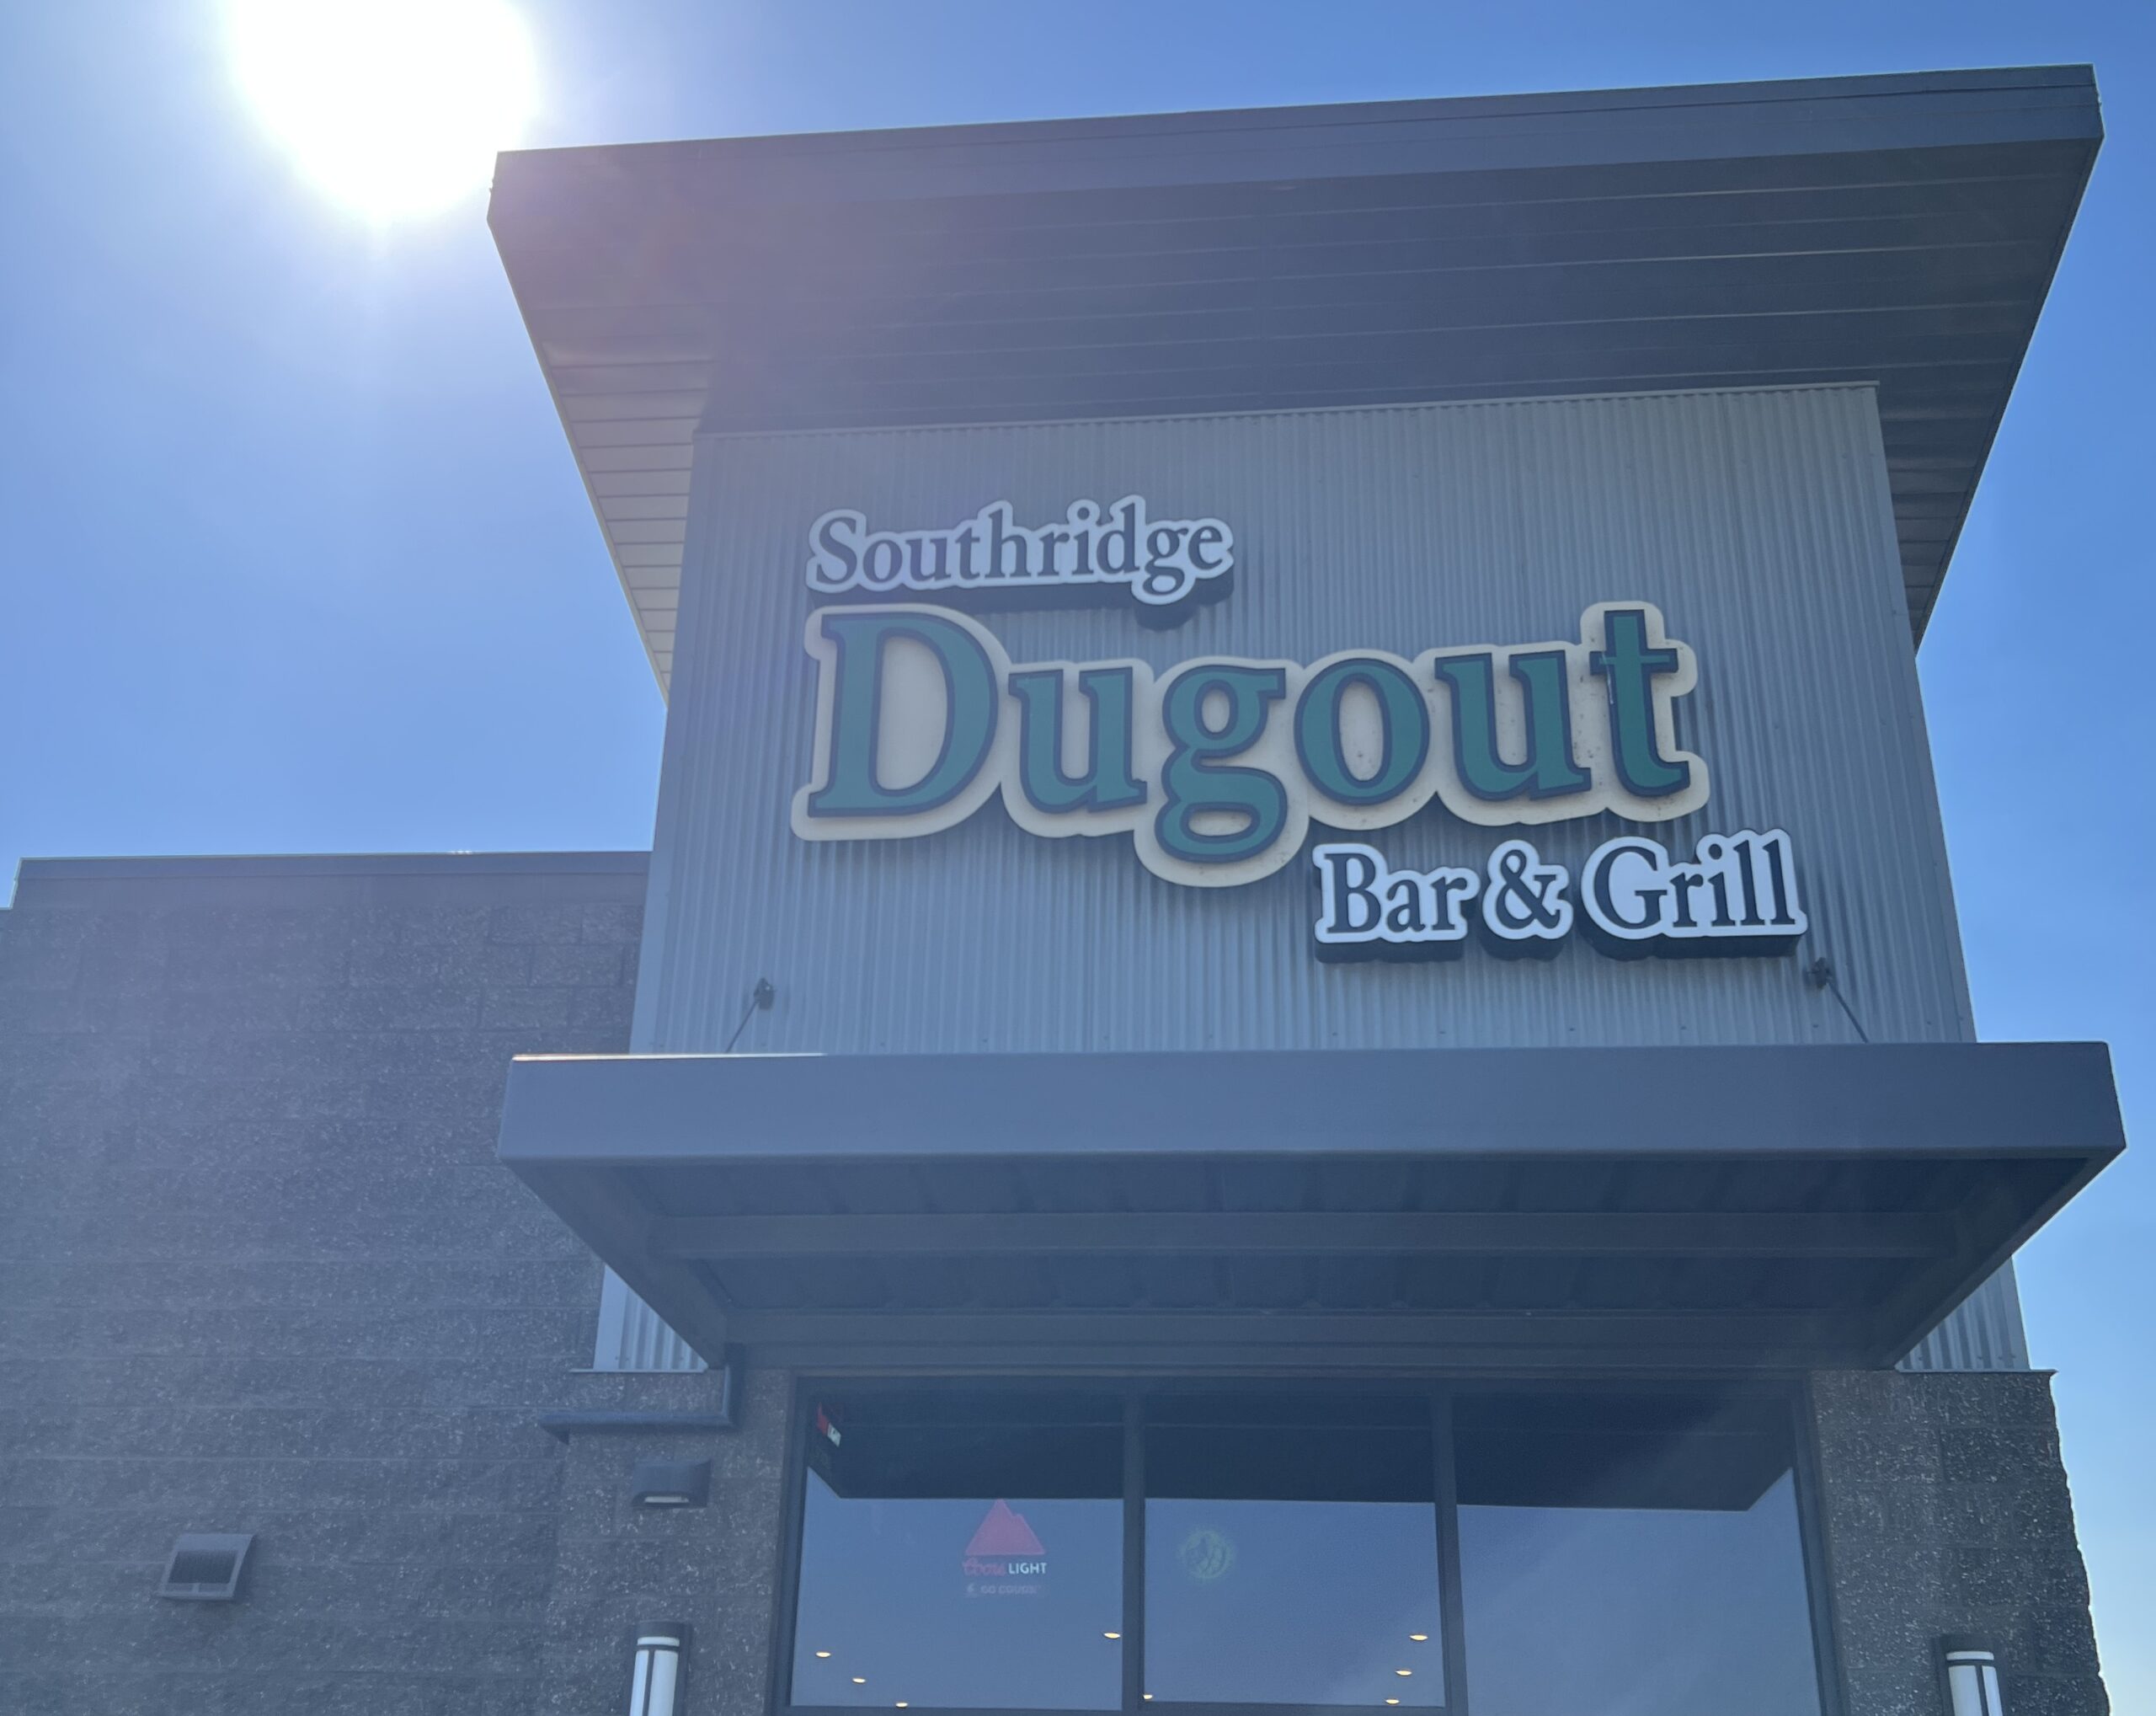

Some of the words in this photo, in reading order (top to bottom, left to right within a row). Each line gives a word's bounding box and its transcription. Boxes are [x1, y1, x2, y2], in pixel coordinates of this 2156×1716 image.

[814, 502, 1225, 596] Southridge
[807, 607, 1692, 864] Dugout
[1323, 851, 1469, 935] Bar
[1495, 847, 1562, 931] &
[1593, 837, 1797, 931] Grill
[1008, 1562, 1048, 1574] LIGHT
